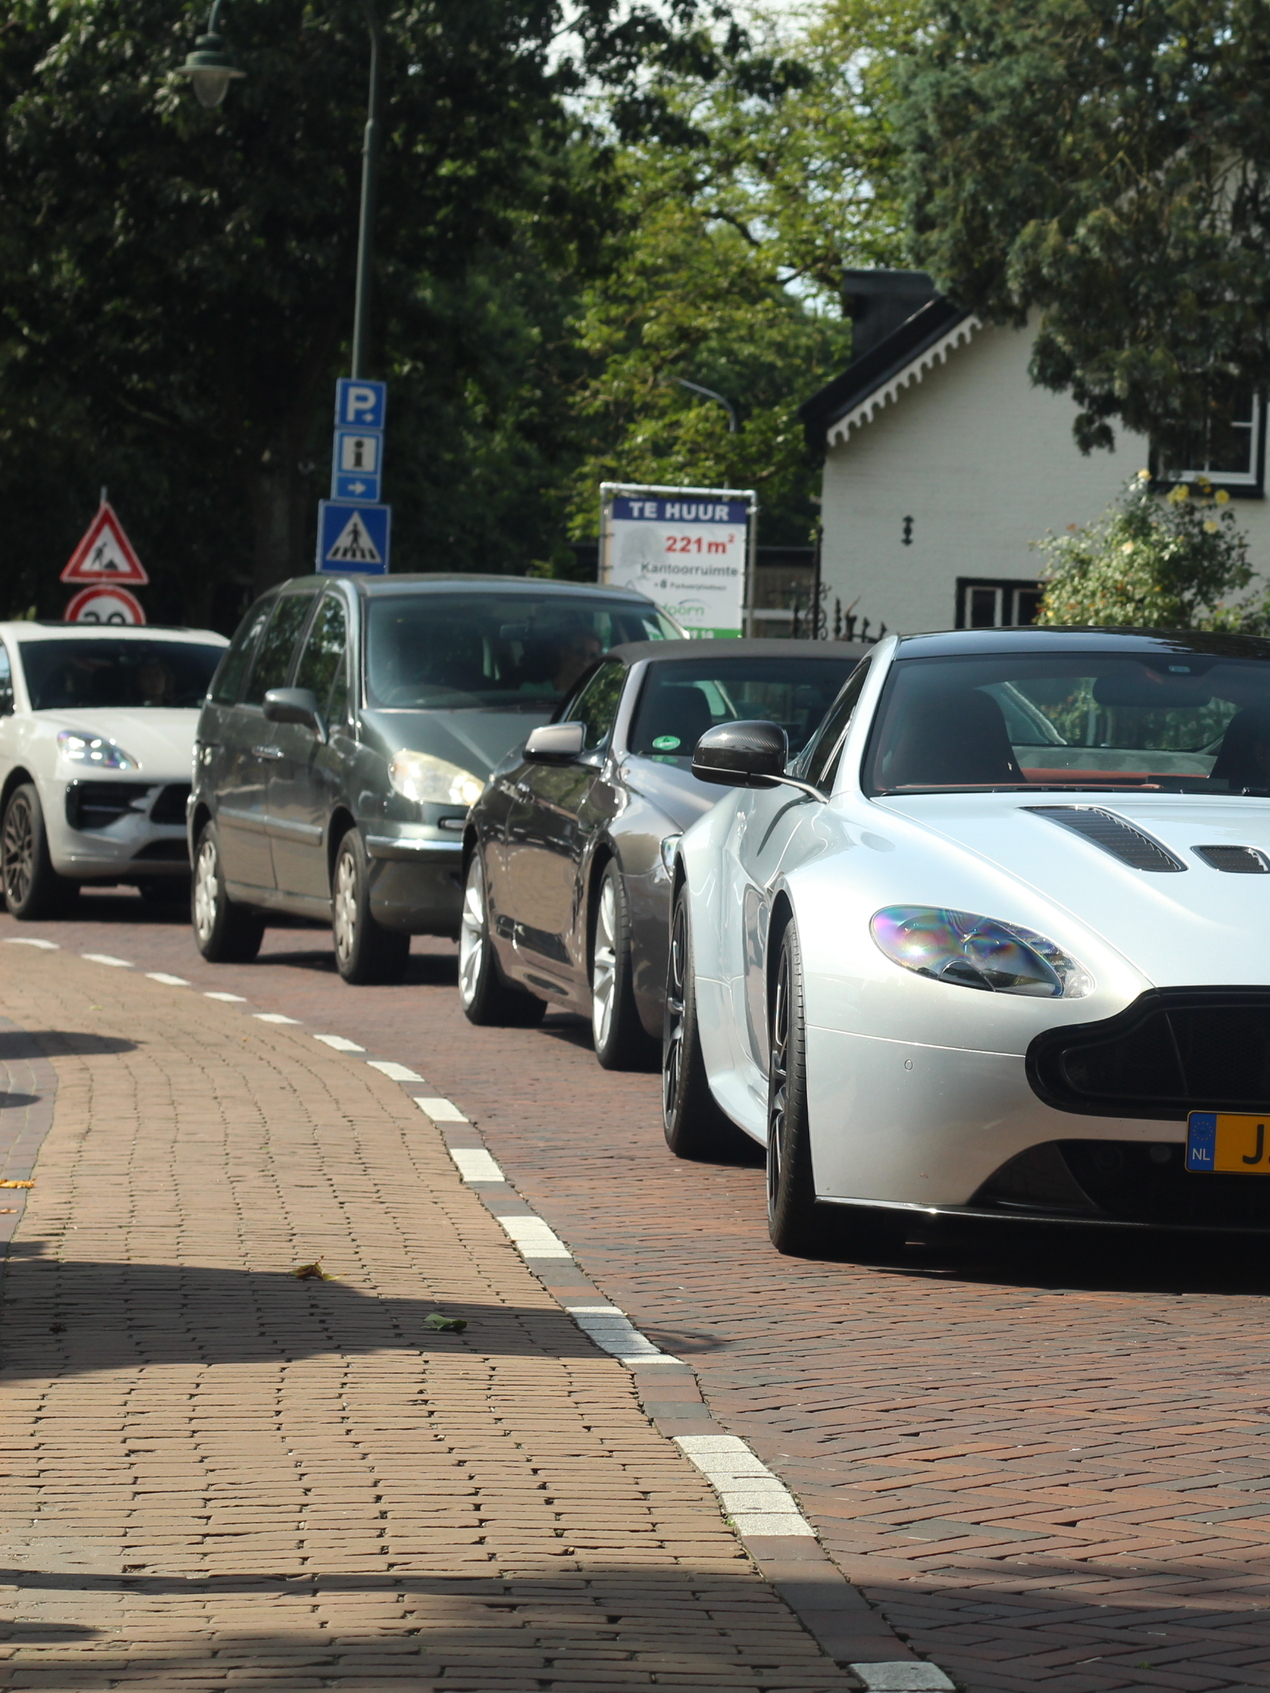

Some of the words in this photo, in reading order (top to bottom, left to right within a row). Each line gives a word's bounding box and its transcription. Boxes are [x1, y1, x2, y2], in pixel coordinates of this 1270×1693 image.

[347, 386, 376, 422] P
[629, 501, 658, 518] TE
[665, 503, 729, 521] HUUR
[641, 562, 738, 576] Kantoorruimte
[1192, 1148, 1211, 1161] NL
